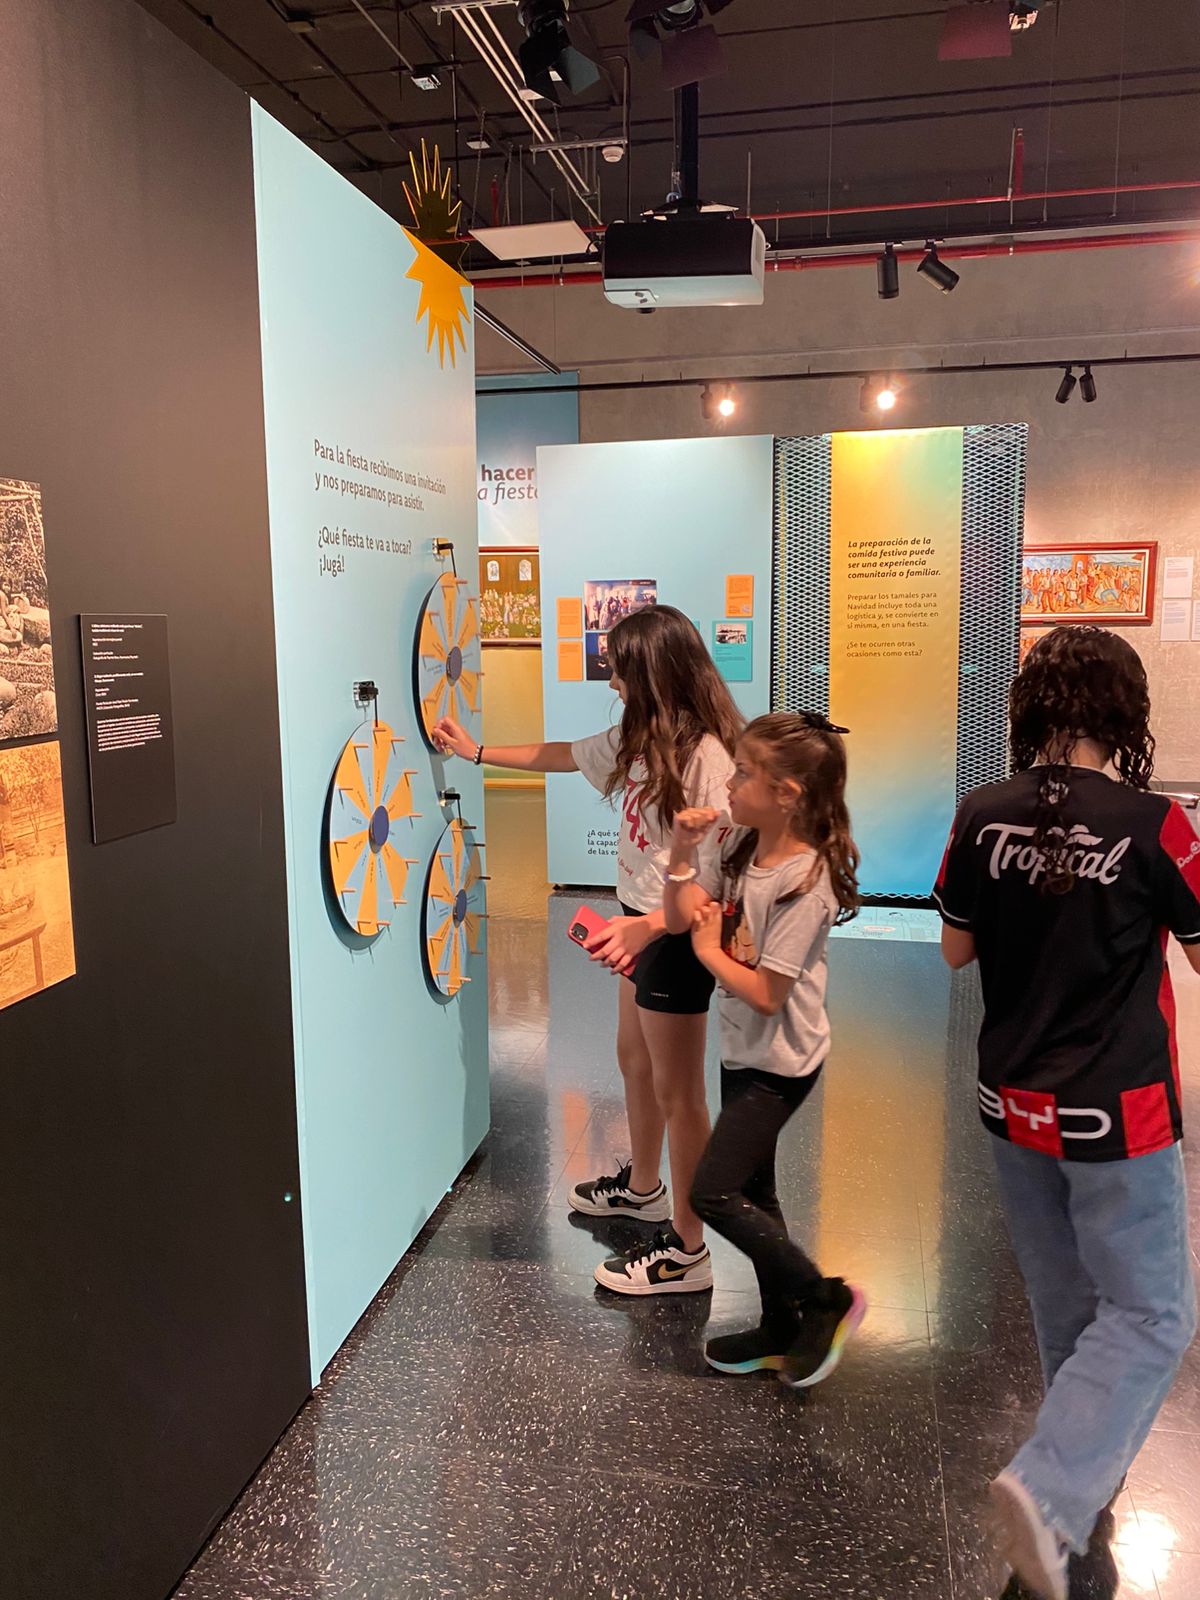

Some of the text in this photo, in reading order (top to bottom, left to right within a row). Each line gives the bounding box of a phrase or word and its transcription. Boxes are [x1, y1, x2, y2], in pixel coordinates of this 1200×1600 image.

[314, 439, 446, 495] Para la fiesta recibimos una invitación
[481, 464, 535, 481] hacer
[315, 472, 425, 511] y nos preparamos para asistir.
[318, 526, 412, 555] ¿Qué fiesta te va a tocar?
[859, 537, 908, 549] preparación
[910, 537, 920, 545] de
[922, 537, 931, 545] la
[848, 547, 935, 559] comida festiva puede
[319, 554, 345, 577] ¡Jugá!
[879, 558, 927, 569] experiencia
[848, 570, 897, 579] comunitaria
[905, 568, 941, 578] familiar.
[848, 594, 877, 602] Preparar
[878, 602, 903, 610] incluye
[847, 612, 876, 621] logística
[854, 622, 880, 630] misma,
[907, 620, 929, 628] fiesta.
[847, 641, 858, 650] ¿Se
[587, 830, 596, 838] ¿A
[597, 829, 611, 838] qué
